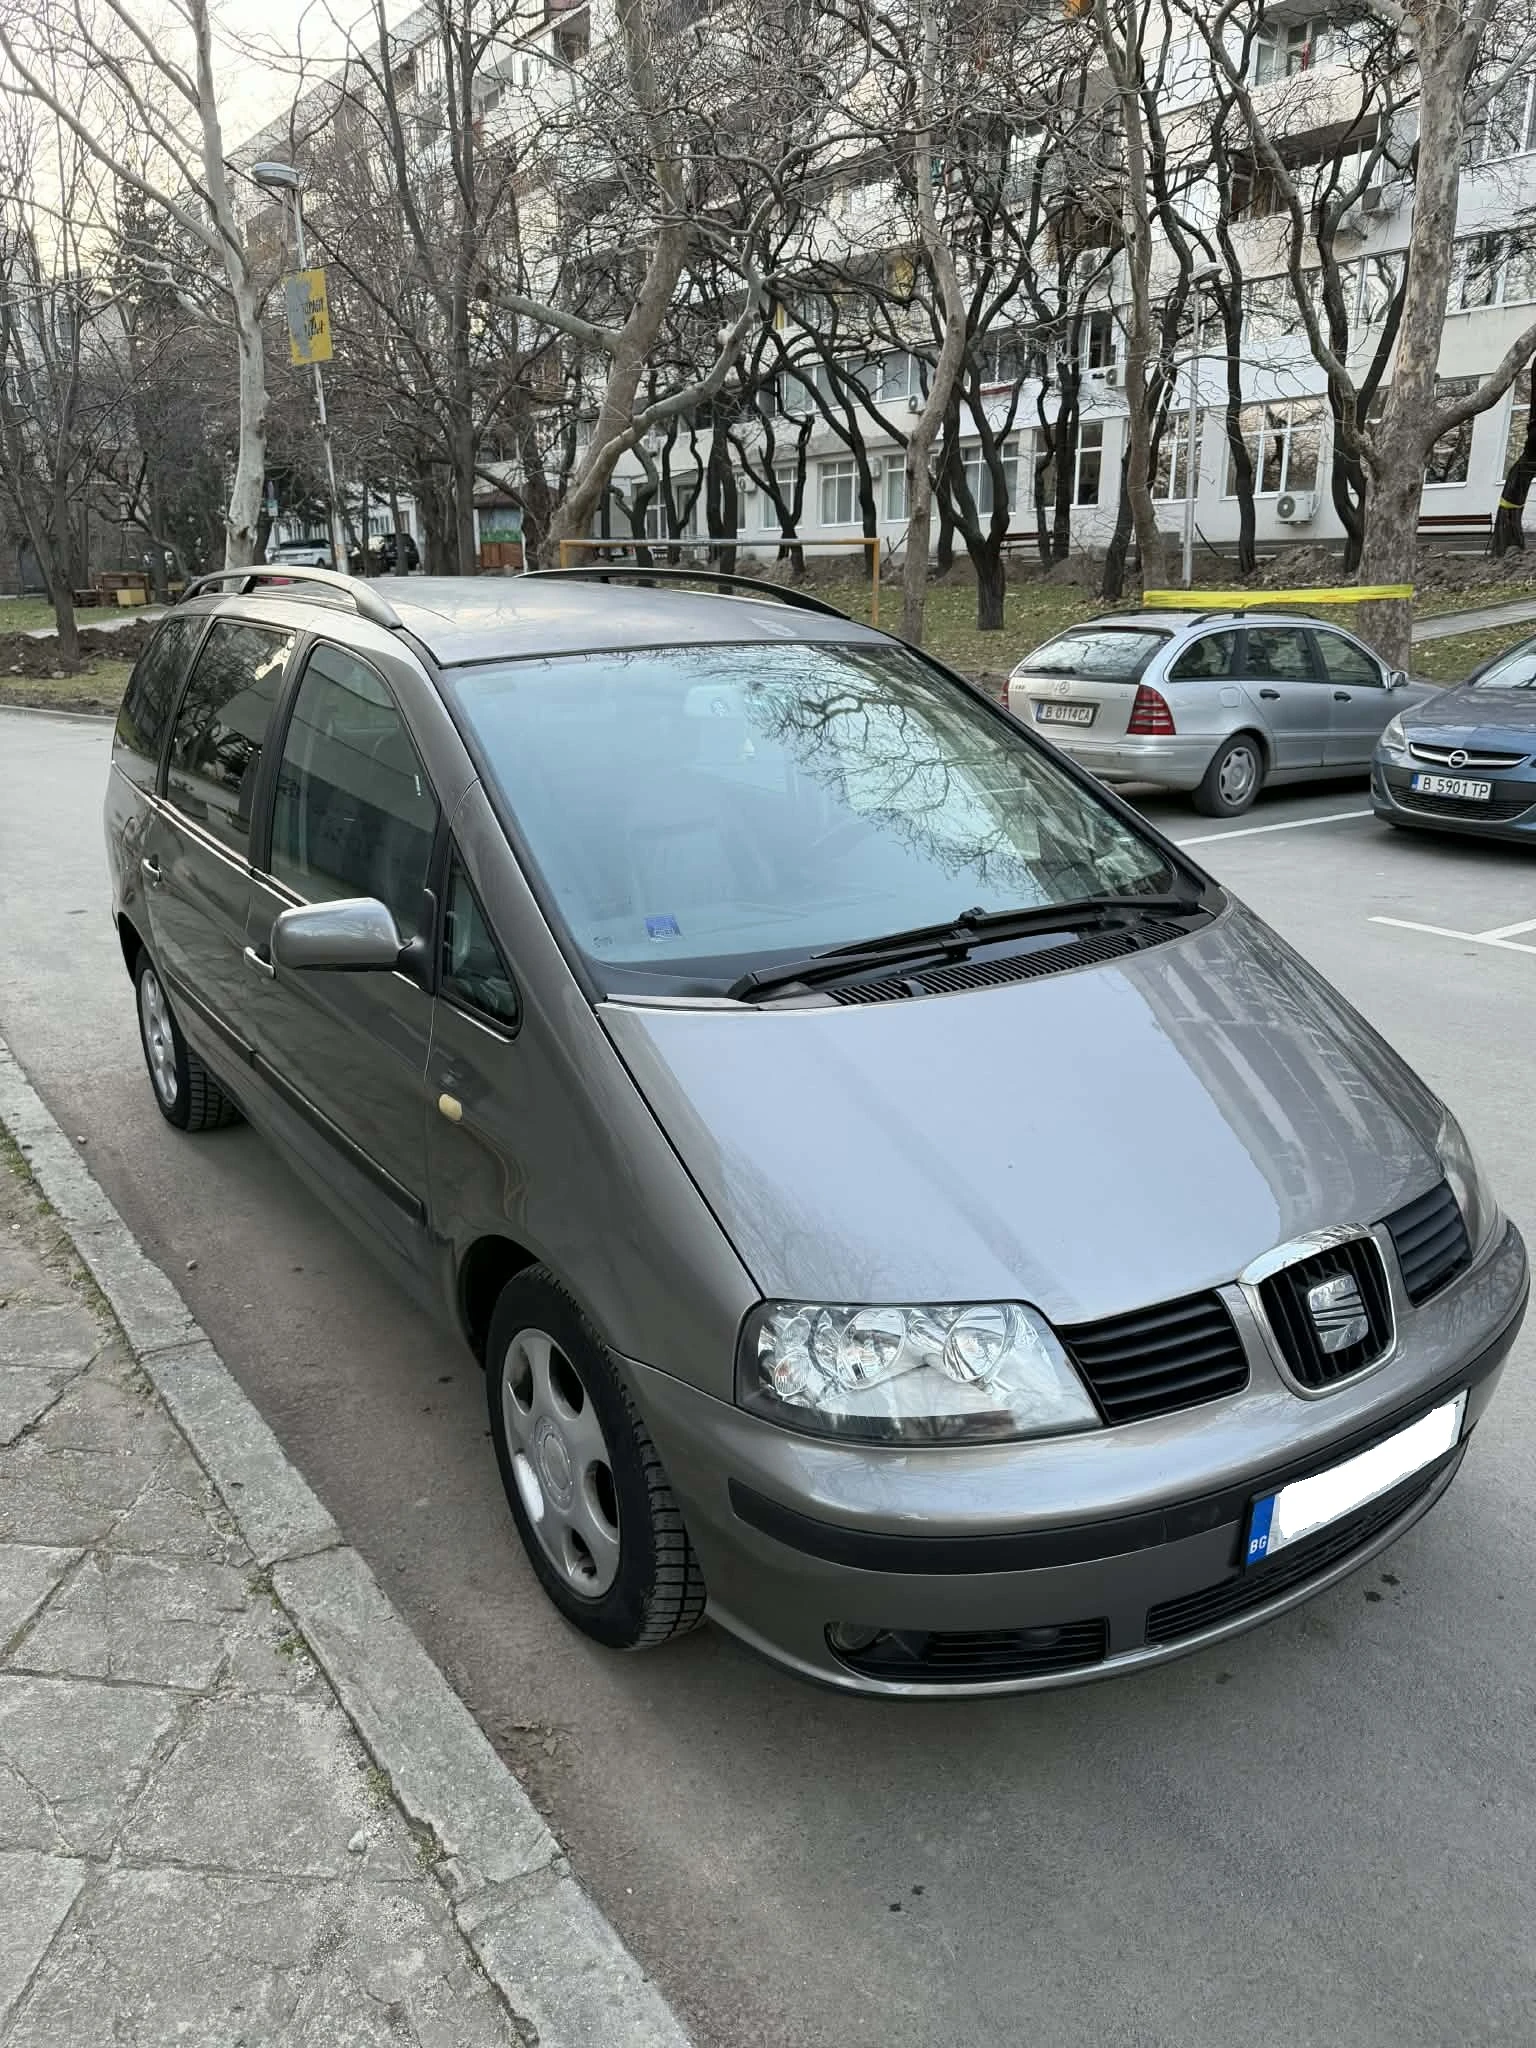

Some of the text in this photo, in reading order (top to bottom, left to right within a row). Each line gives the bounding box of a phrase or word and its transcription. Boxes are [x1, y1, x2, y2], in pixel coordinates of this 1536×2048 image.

[1423, 776, 1489, 796] B 5901 TP
[1249, 1535, 1267, 1554] BG
